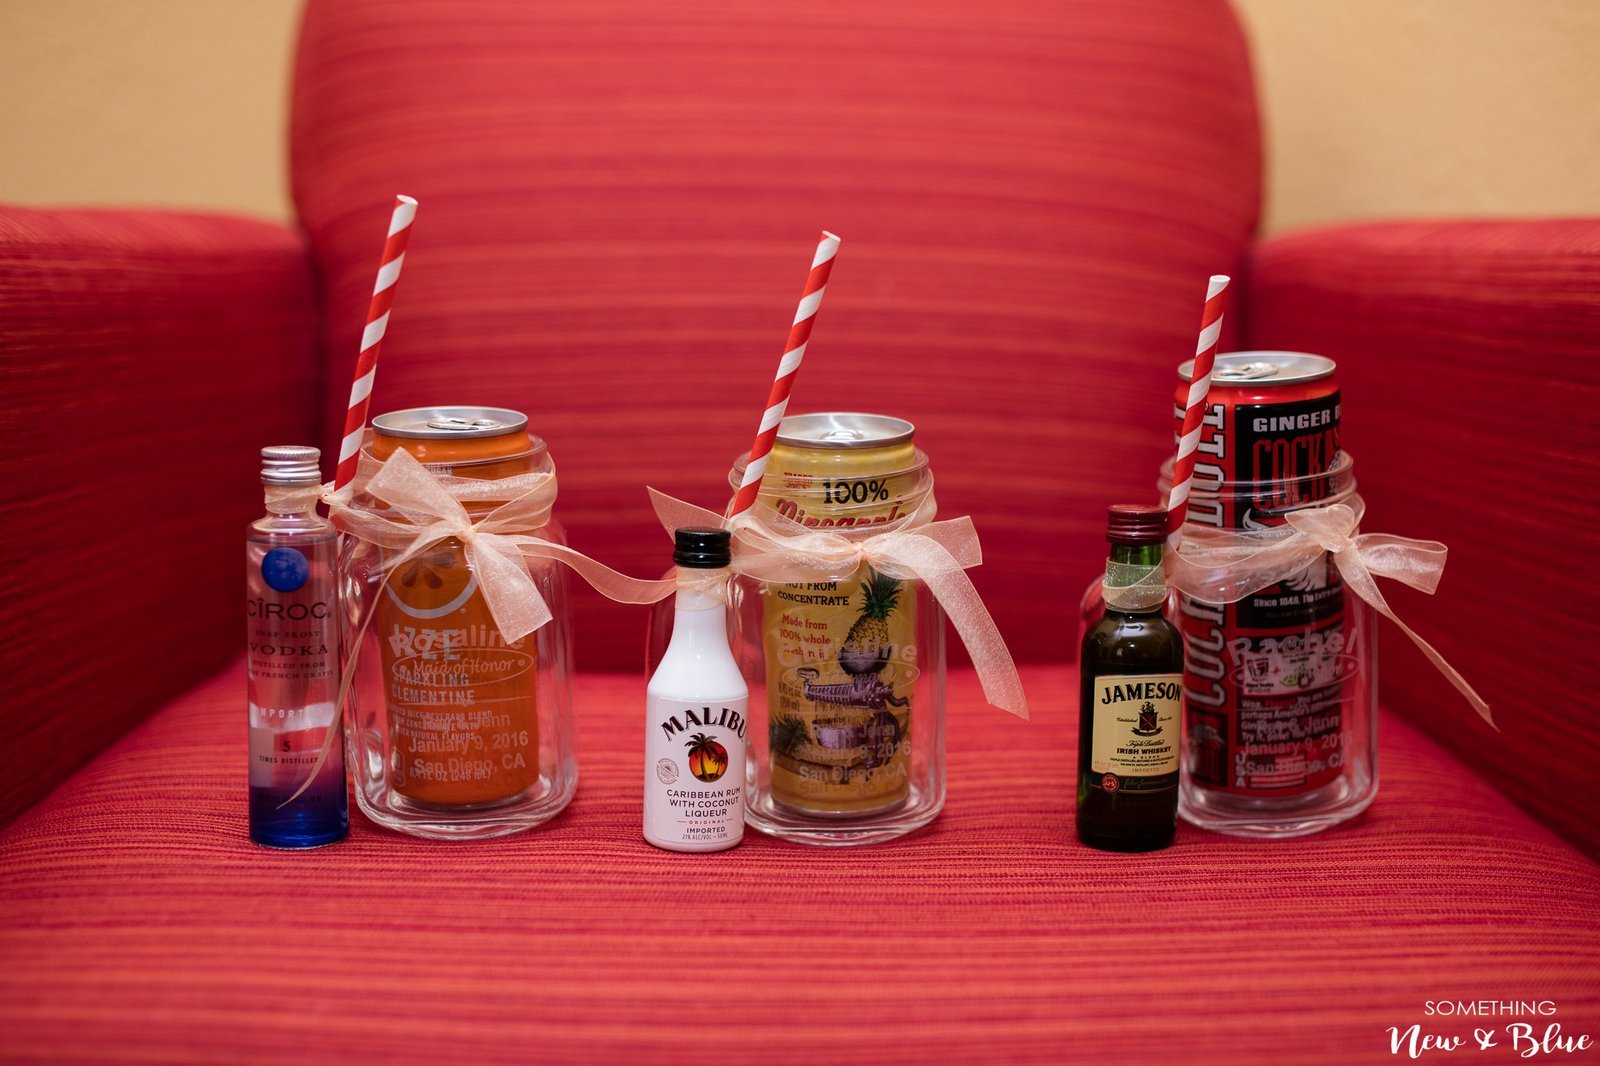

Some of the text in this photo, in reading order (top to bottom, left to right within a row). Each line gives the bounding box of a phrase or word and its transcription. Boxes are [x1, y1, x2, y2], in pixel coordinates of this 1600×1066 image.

[1253, 409, 1330, 432] GINGER
[822, 480, 889, 504] 100%
[807, 582, 837, 591] FROM
[778, 590, 849, 606] CONCENTRATE
[782, 613, 828, 630] Made from
[285, 631, 320, 639] FROST
[780, 628, 831, 645] 100% whole
[250, 641, 328, 656] VODKA
[252, 660, 326, 670] DISTILLED FROM
[413, 658, 514, 677] Maid of Honor
[262, 671, 299, 680] FRENCH
[393, 670, 469, 688] SPARKLING
[392, 684, 474, 705] CLEMENTINE
[1101, 682, 1181, 704] JAMESON
[661, 706, 747, 742] MALIBU
[408, 730, 529, 755] January 9, 2016
[411, 729, 440, 741] NATURAL
[441, 731, 475, 743] FLAVORS
[283, 741, 291, 752] 5
[1141, 746, 1171, 755] WHISKEY
[1241, 739, 1300, 757] January
[260, 755, 278, 763] TIMES
[413, 753, 526, 776] San Diego, CA
[799, 765, 828, 781] San
[667, 786, 741, 799] CARIBBEAN RUM
[669, 796, 740, 808] WITH COCONUT
[685, 809, 728, 818] LIQUEUR
[686, 826, 726, 834] IMPORTED
